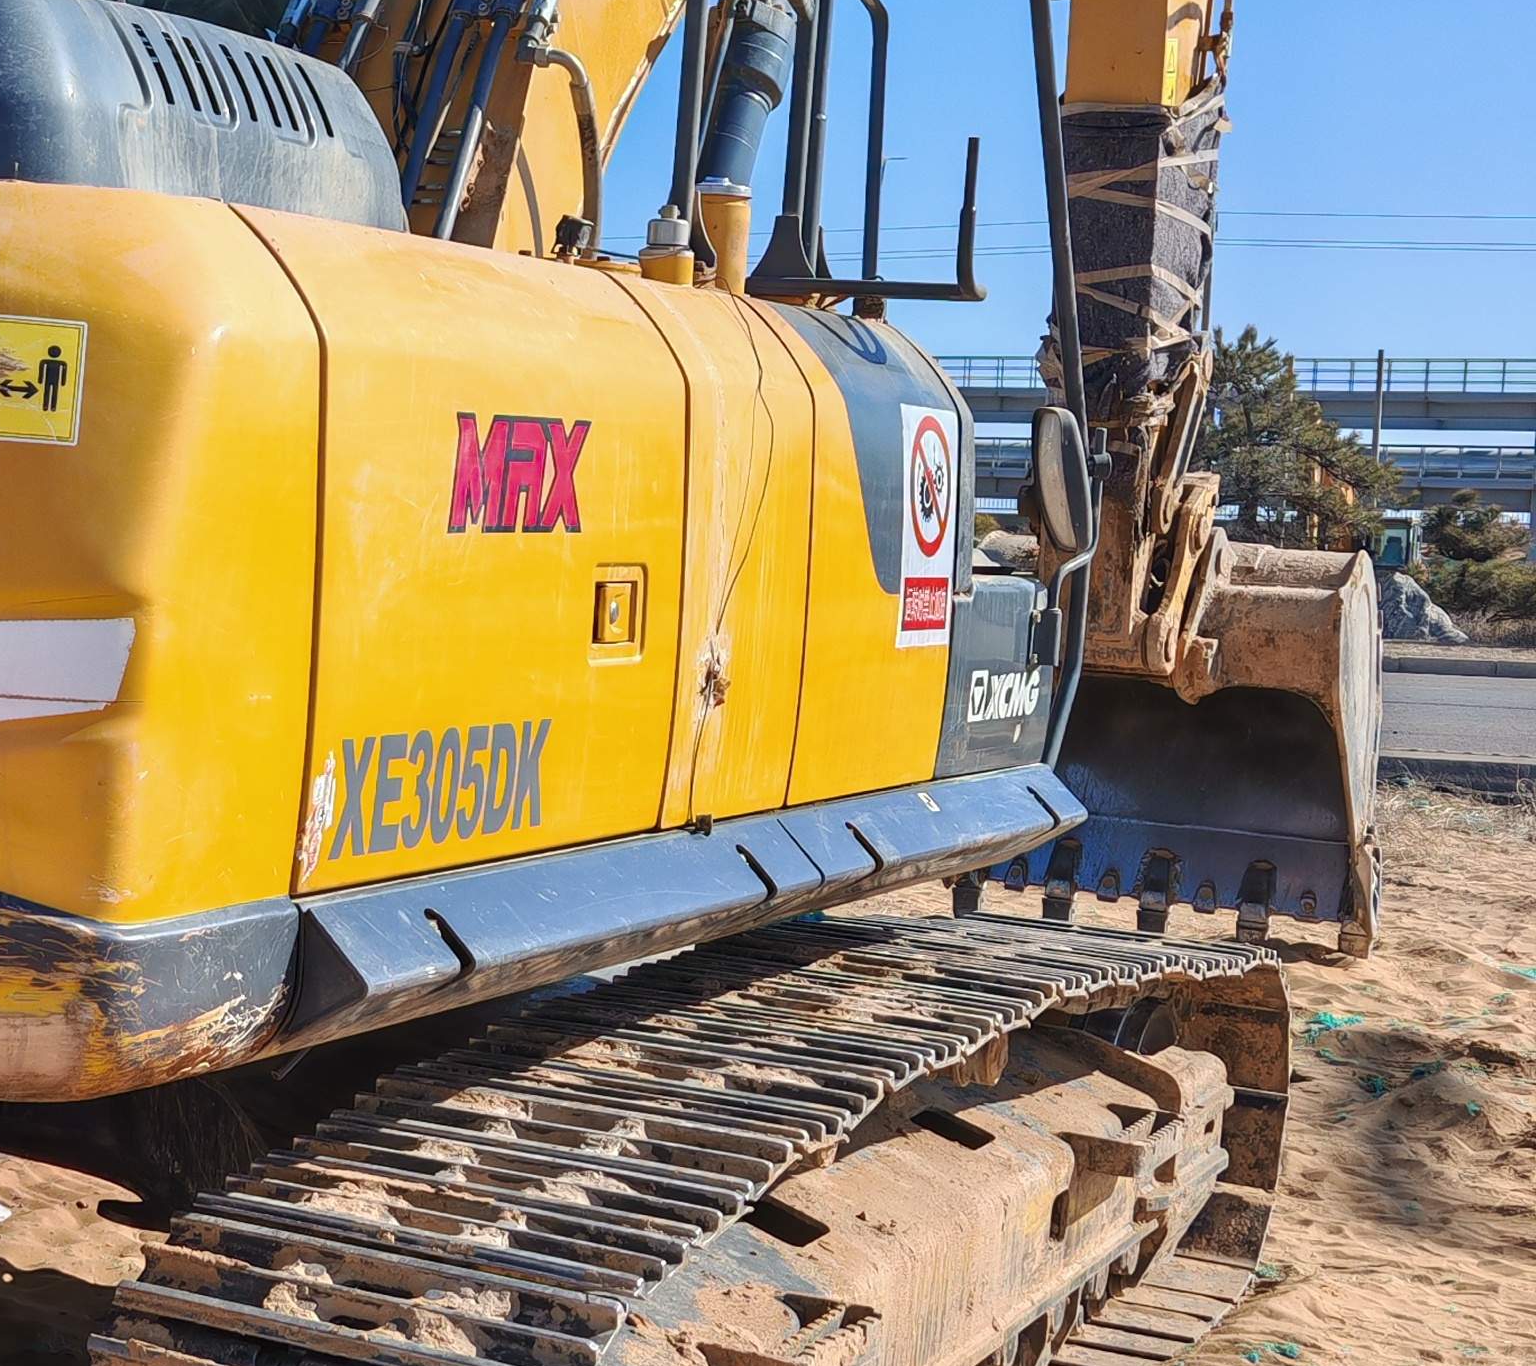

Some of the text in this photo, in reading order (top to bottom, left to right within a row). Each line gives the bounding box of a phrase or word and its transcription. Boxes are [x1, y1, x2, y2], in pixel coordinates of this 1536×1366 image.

[447, 411, 592, 534] MAX
[984, 669, 1041, 721] XCMG
[327, 718, 553, 861] XE305DK
